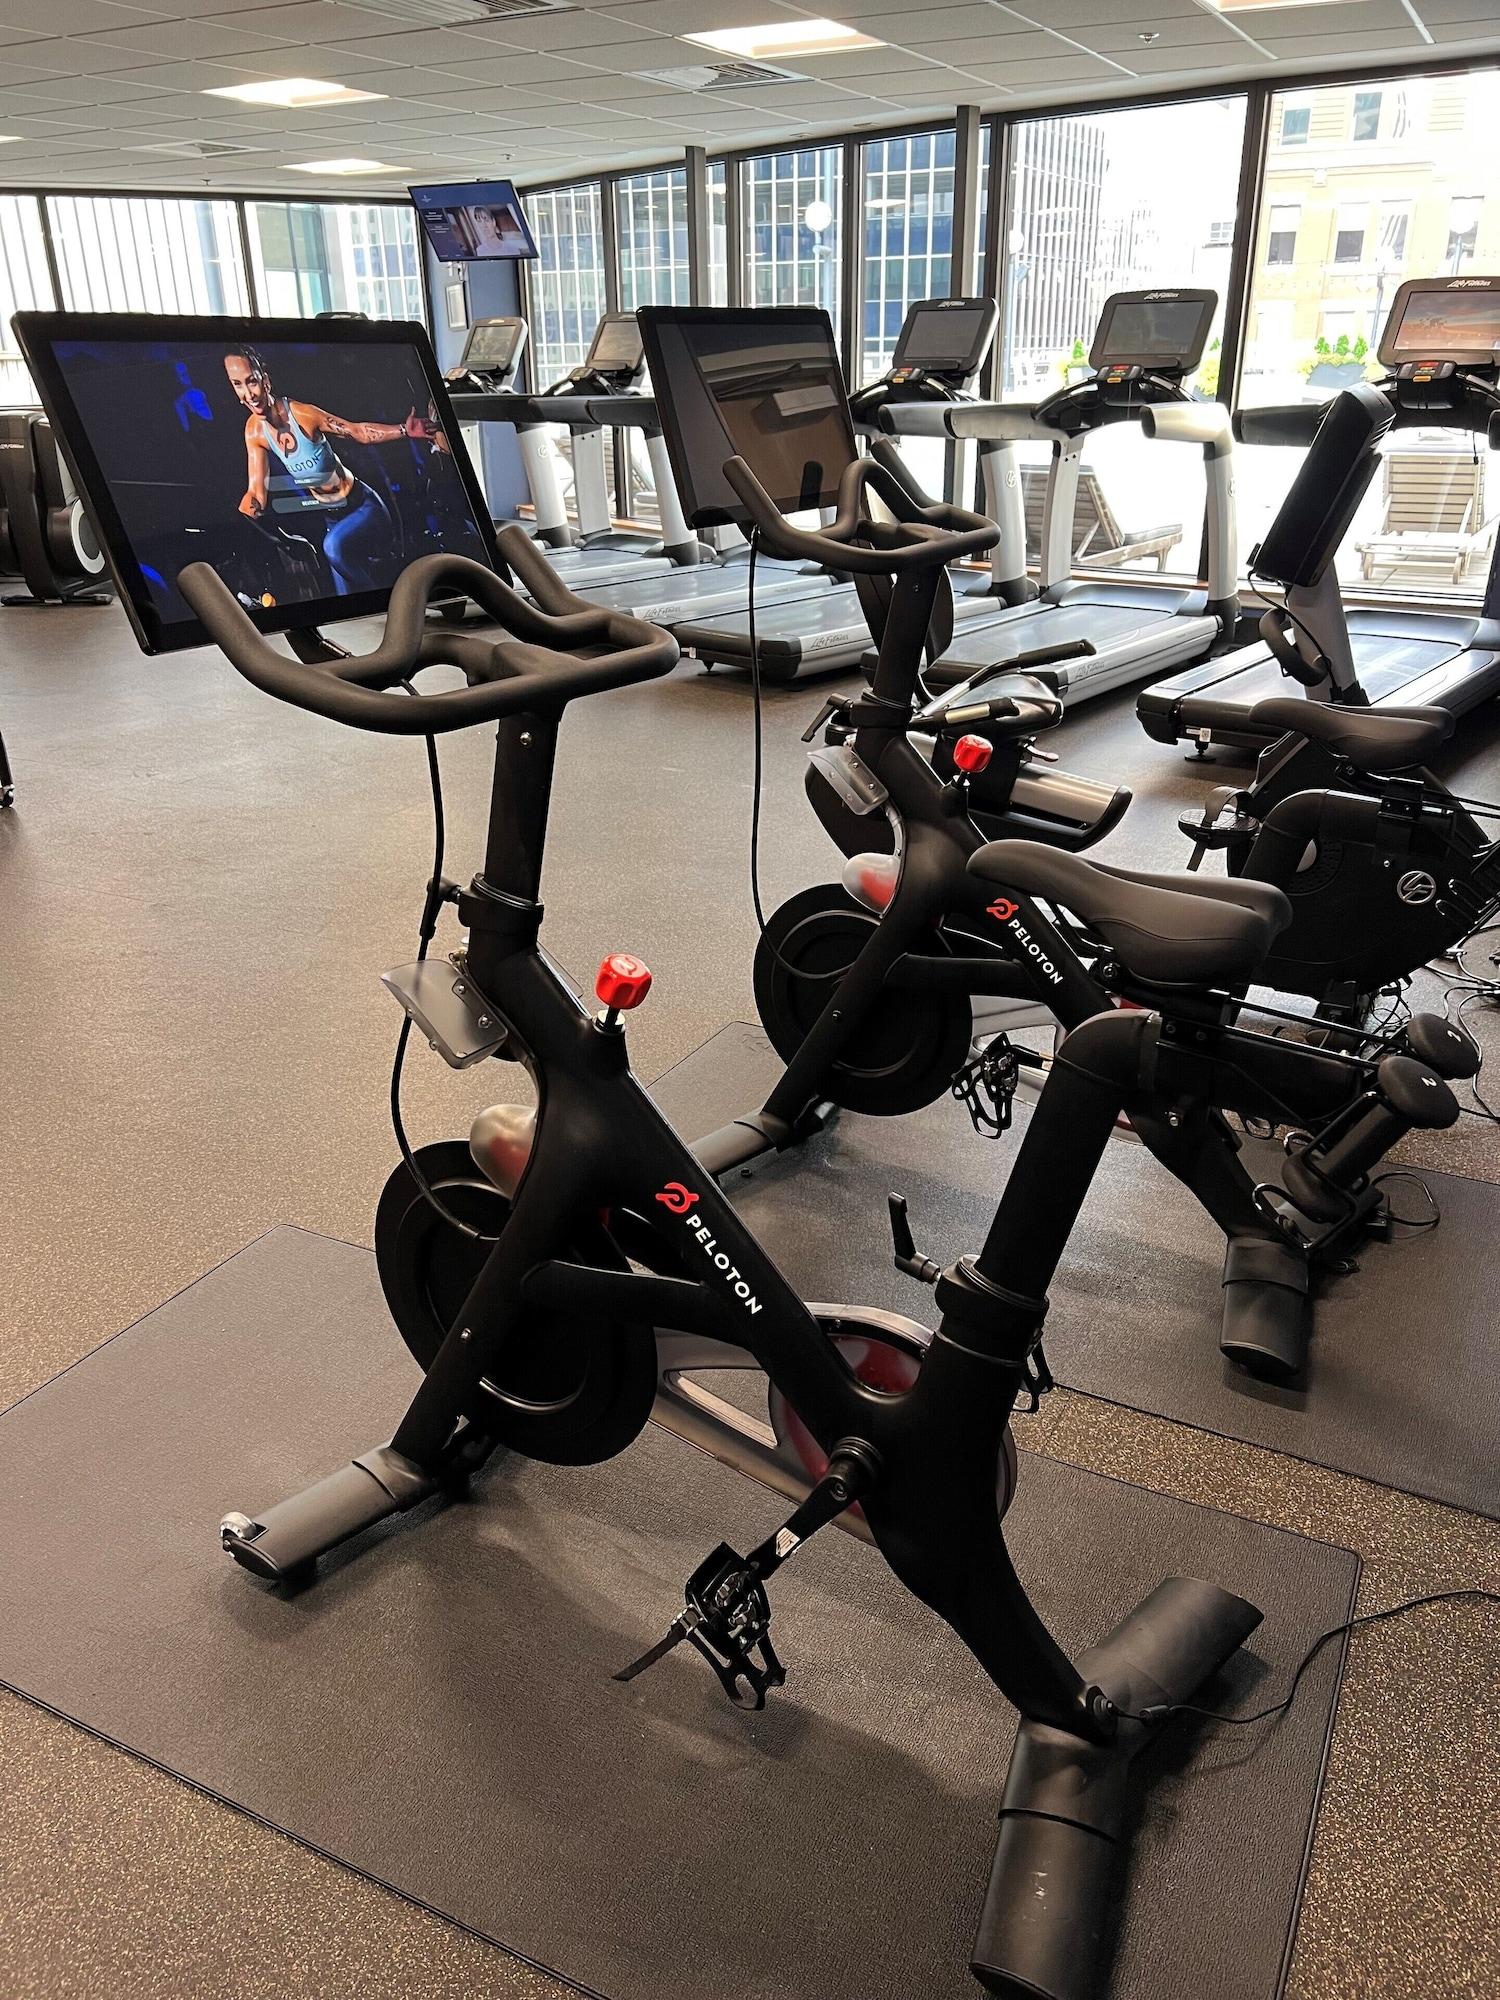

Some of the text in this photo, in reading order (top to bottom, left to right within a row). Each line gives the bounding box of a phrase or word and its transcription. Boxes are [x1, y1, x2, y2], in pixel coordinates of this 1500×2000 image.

[1008, 918, 1064, 985] PELOTON
[1421, 1077, 1437, 1087] 2
[685, 1214, 763, 1315] PELOTON
